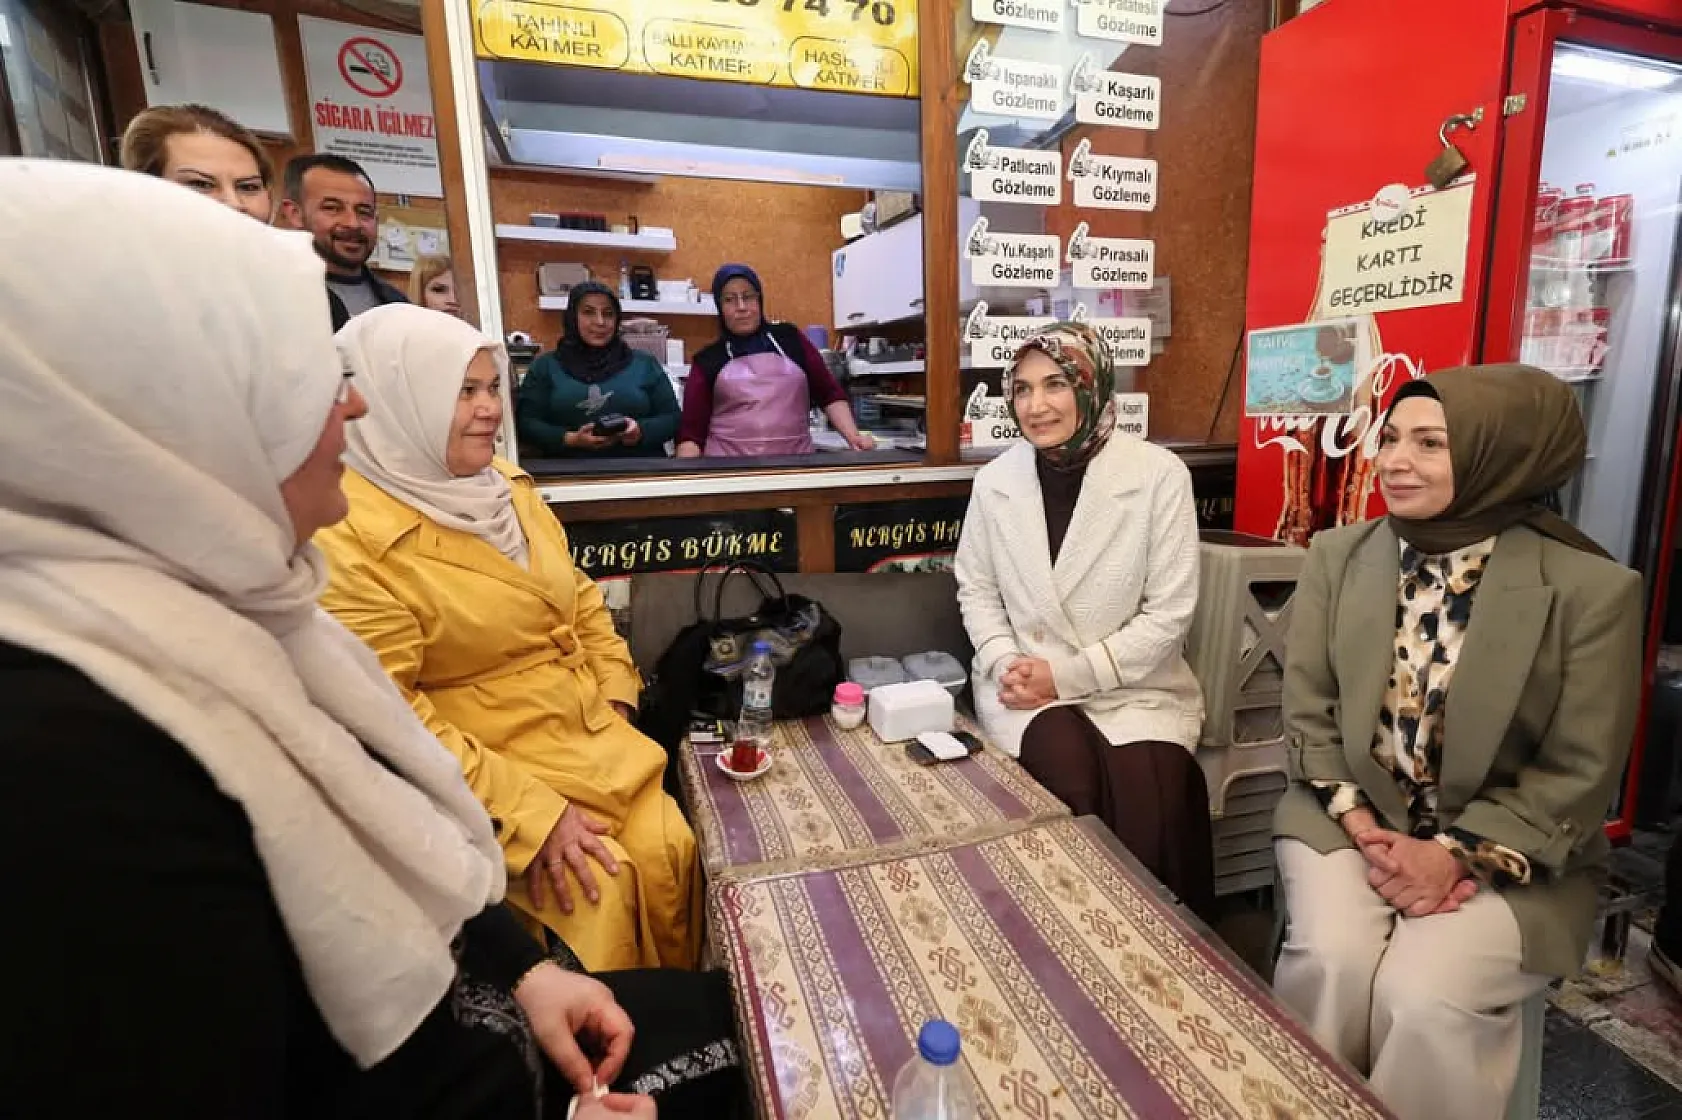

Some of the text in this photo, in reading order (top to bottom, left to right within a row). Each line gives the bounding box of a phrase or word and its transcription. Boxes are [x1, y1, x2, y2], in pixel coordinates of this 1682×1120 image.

[992, 0, 1059, 24] Gözleme
[1097, 14, 1157, 38] Gözleme
[509, 33, 602, 58] KATMER
[1003, 67, 1058, 88] Ispanaklı
[992, 89, 1057, 112] Gözleme
[1108, 79, 1154, 102] Kaşarlı
[315, 97, 435, 138] SİGARA İÇİLMEZ
[1095, 100, 1154, 122] Gözleme
[1001, 156, 1056, 176] Patlıcanlı
[1101, 164, 1152, 185] Kıymalı
[992, 177, 1056, 197] Gözleme
[1092, 185, 1151, 204] Gözleme
[1361, 203, 1428, 240] KREDİ
[1000, 242, 1054, 262] Yu.Kaşarlı
[1100, 246, 1149, 263] Pırasalı
[1356, 244, 1423, 273] KARTI
[992, 263, 1054, 280] Gözleme
[1090, 265, 1148, 282] Gözleme
[1329, 270, 1454, 308] GEÇERLİDİR
[1098, 325, 1146, 343] Yoğurtlu
[680, 530, 783, 559] BÜKME
[850, 518, 927, 549] NERGİS
